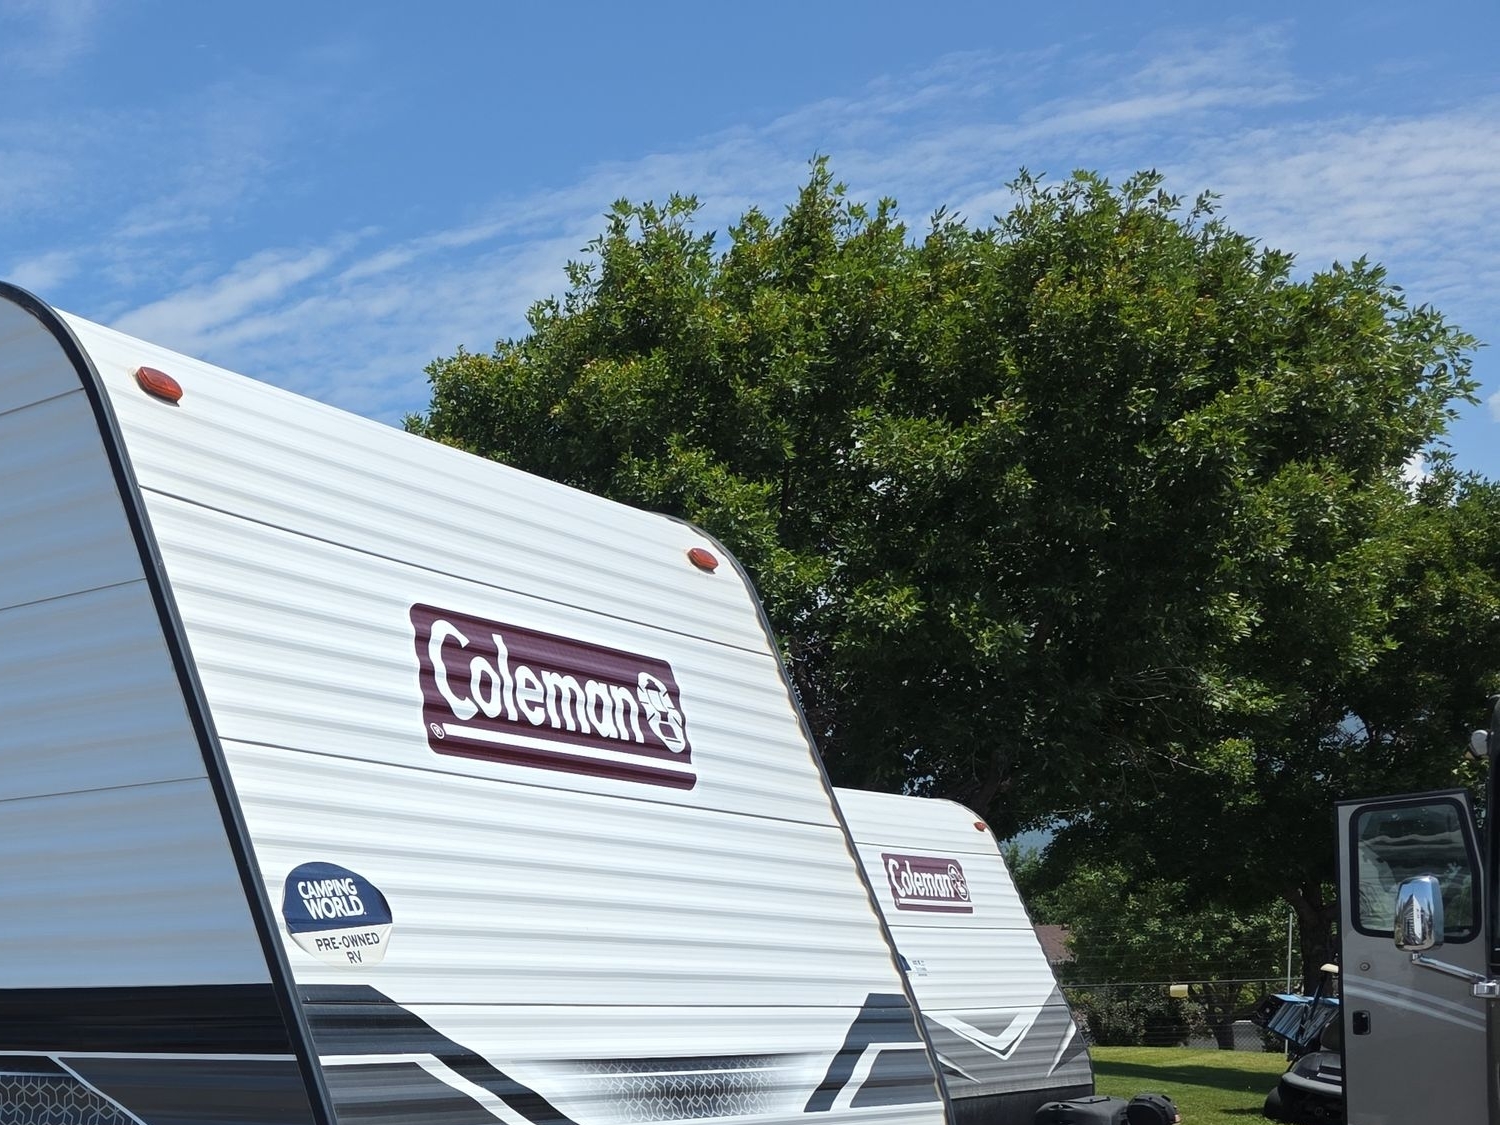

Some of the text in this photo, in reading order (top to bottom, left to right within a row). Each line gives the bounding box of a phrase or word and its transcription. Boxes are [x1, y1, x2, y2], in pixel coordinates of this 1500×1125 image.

[427, 618, 645, 744] Coleman
[297, 877, 358, 900] CAMPING
[888, 858, 956, 898] Coleman
[315, 932, 380, 952] PRE-OWNED
[346, 950, 363, 964] RV
